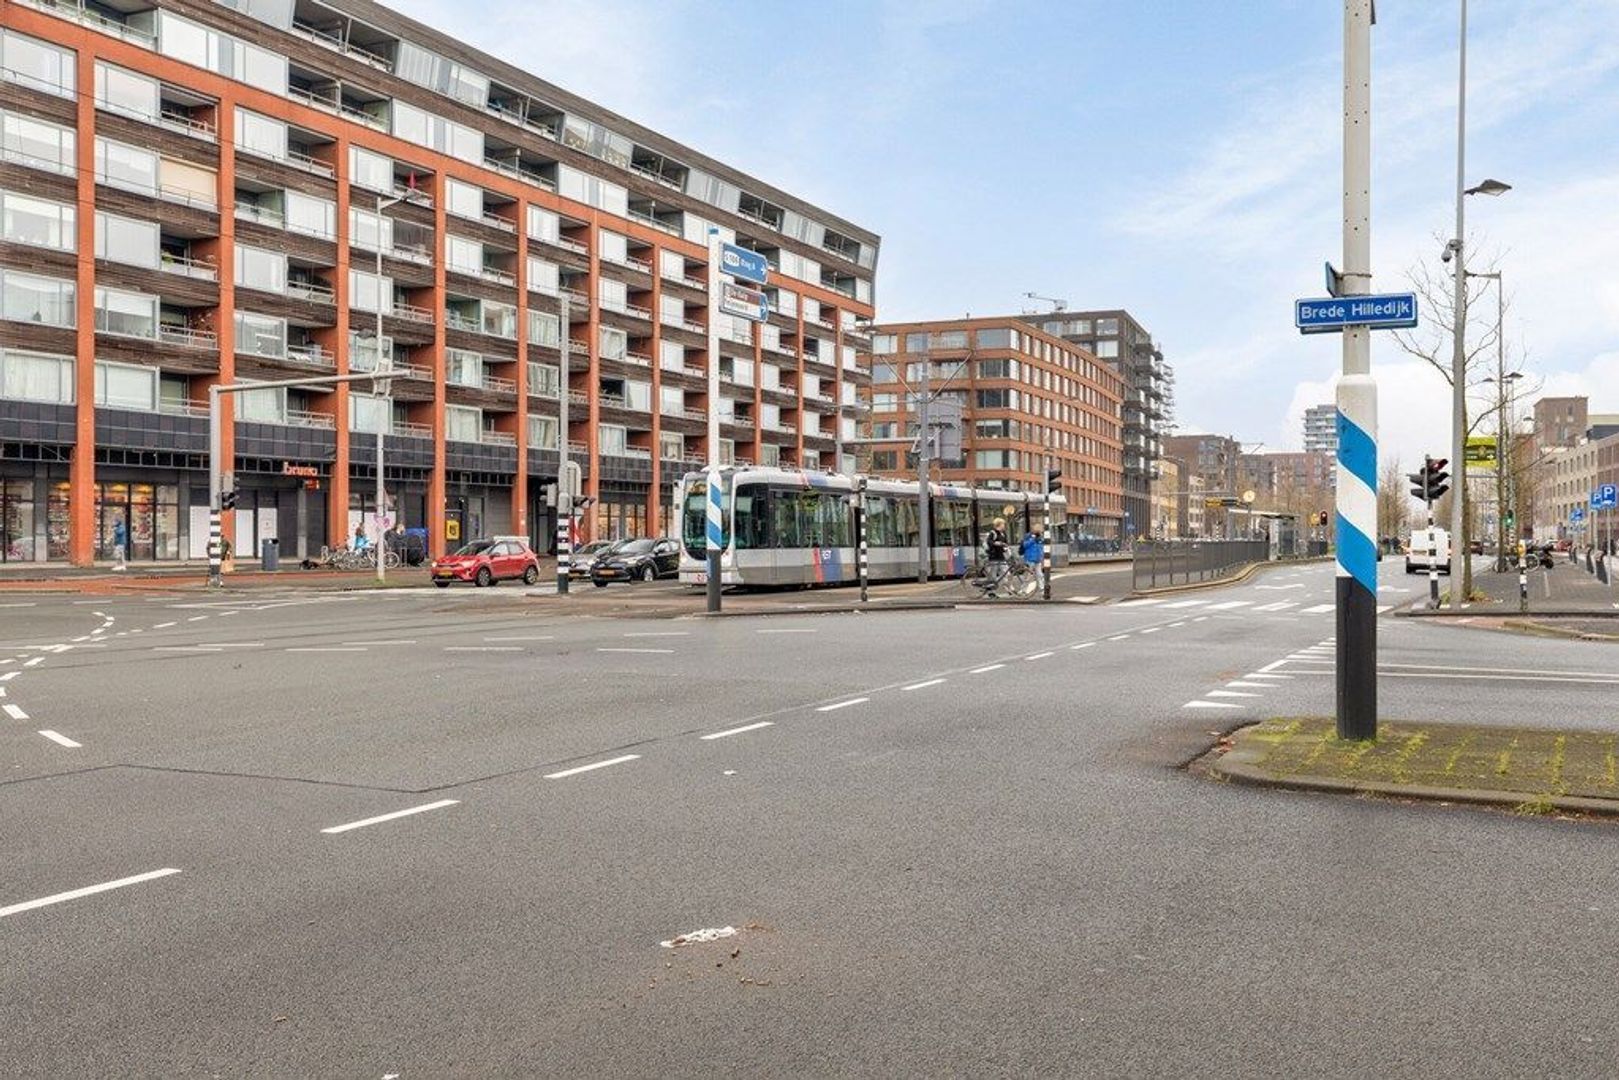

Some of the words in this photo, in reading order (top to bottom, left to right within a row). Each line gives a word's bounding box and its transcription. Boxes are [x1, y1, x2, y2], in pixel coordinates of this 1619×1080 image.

[1301, 305, 1345, 319] Brede
[1352, 301, 1410, 317] Hilledijk
[1604, 487, 1613, 498] P
